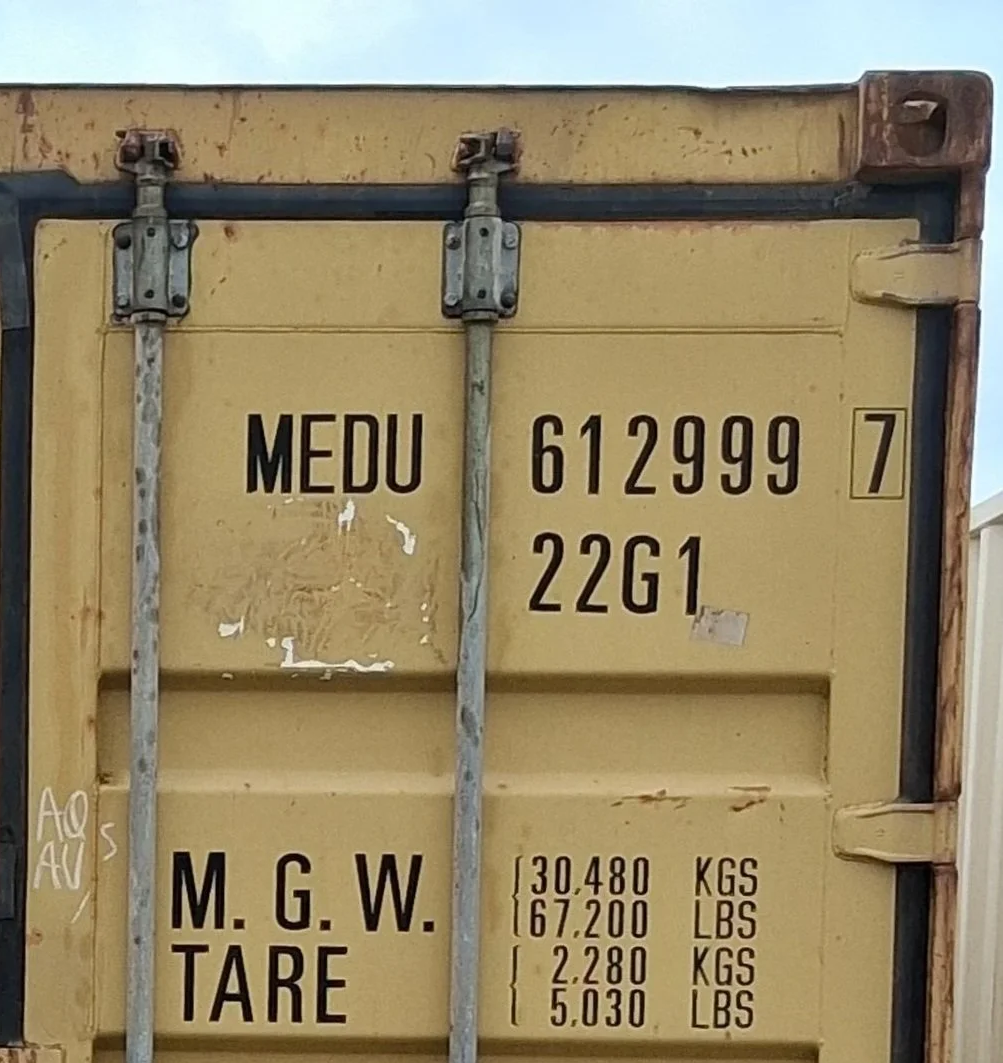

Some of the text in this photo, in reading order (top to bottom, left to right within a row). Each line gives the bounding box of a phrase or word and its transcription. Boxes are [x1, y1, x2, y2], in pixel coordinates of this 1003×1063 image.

[245, 413, 897, 496] MEDU 612999 7
[528, 531, 703, 617] 22G1
[694, 857, 759, 897] KGS
[693, 900, 757, 940] LBS
[170, 943, 349, 1025] TARE
[692, 946, 756, 987] KGS
[690, 988, 755, 1030] LBS
